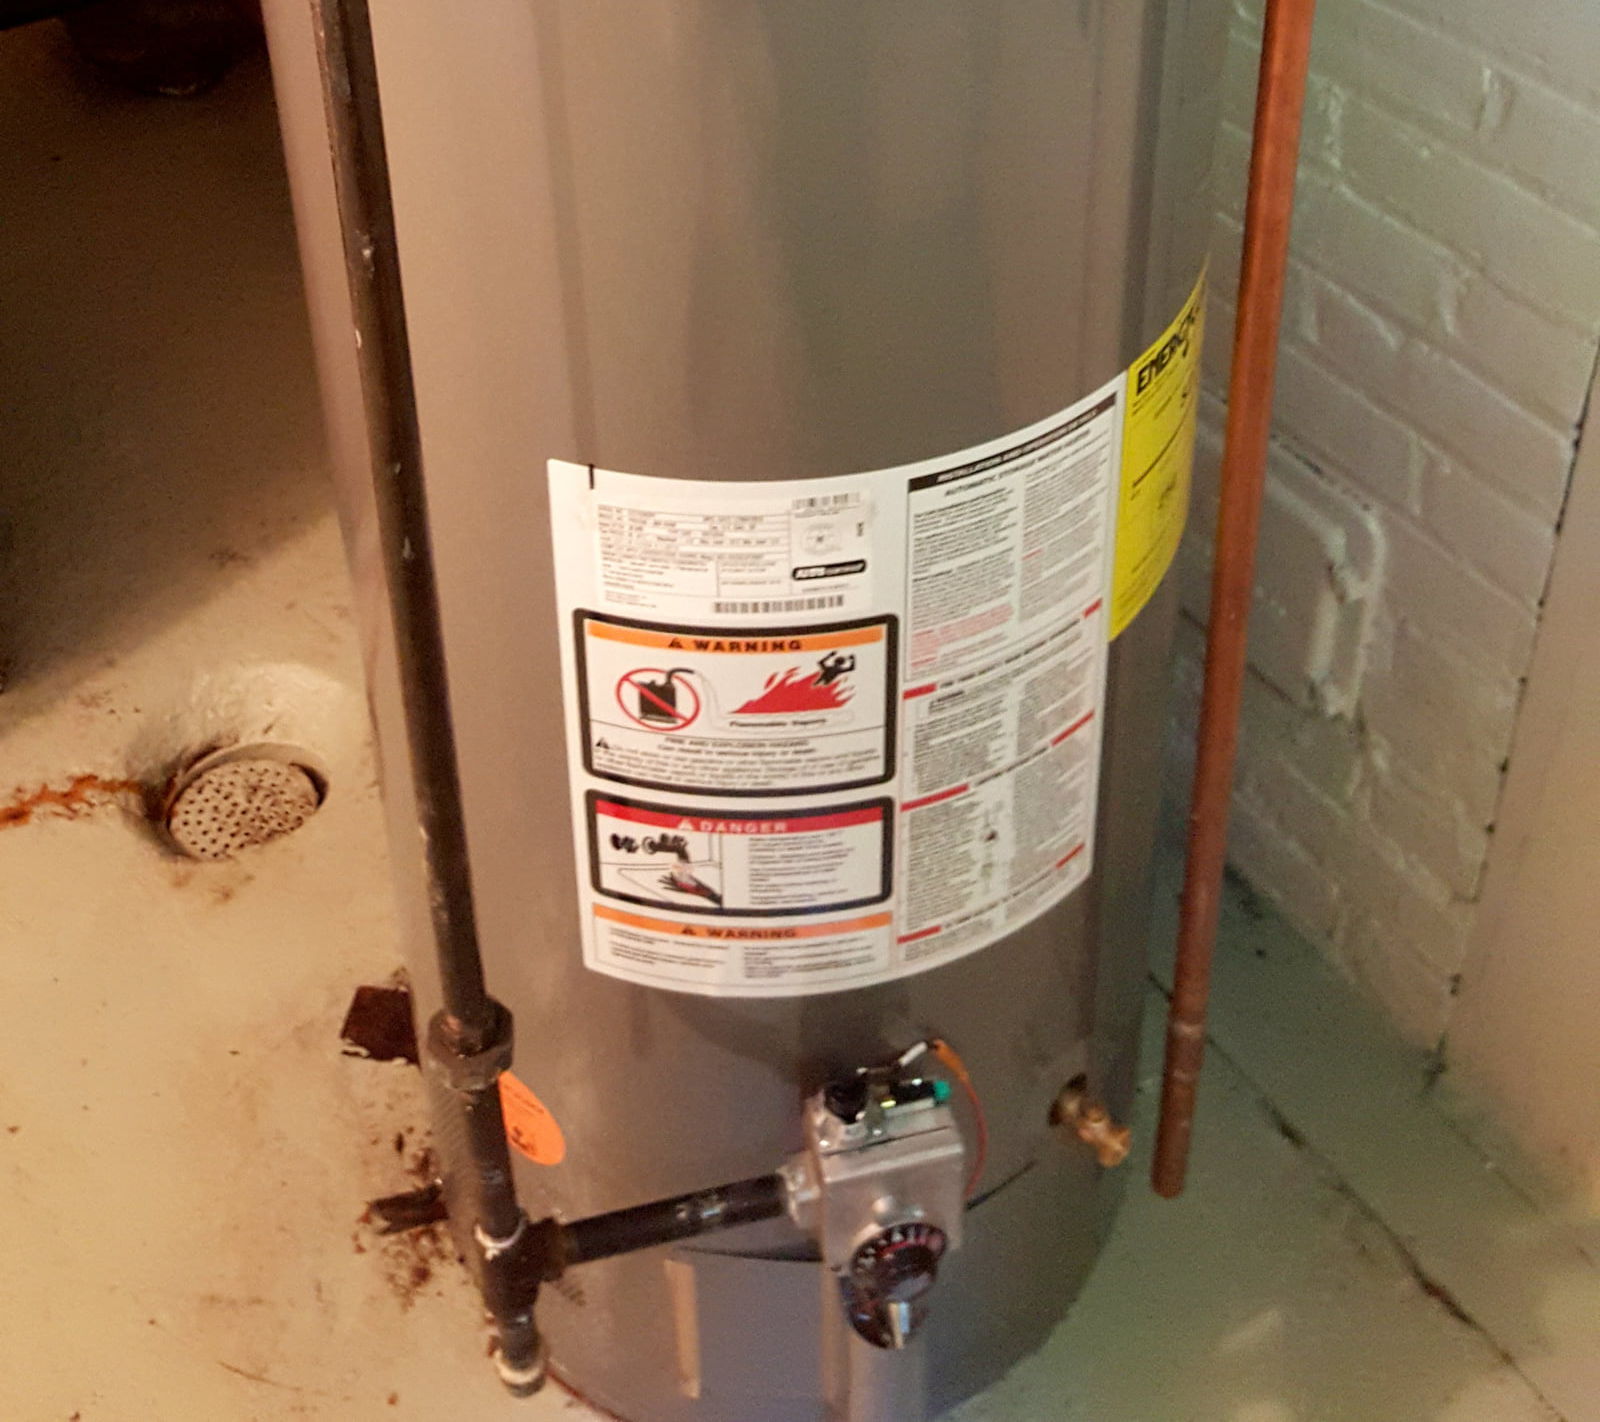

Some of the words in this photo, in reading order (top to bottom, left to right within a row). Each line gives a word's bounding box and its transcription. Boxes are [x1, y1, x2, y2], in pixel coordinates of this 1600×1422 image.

[691, 639, 803, 652] WARNING
[700, 821, 788, 833] DANGER
[706, 928, 797, 940] WARNING
